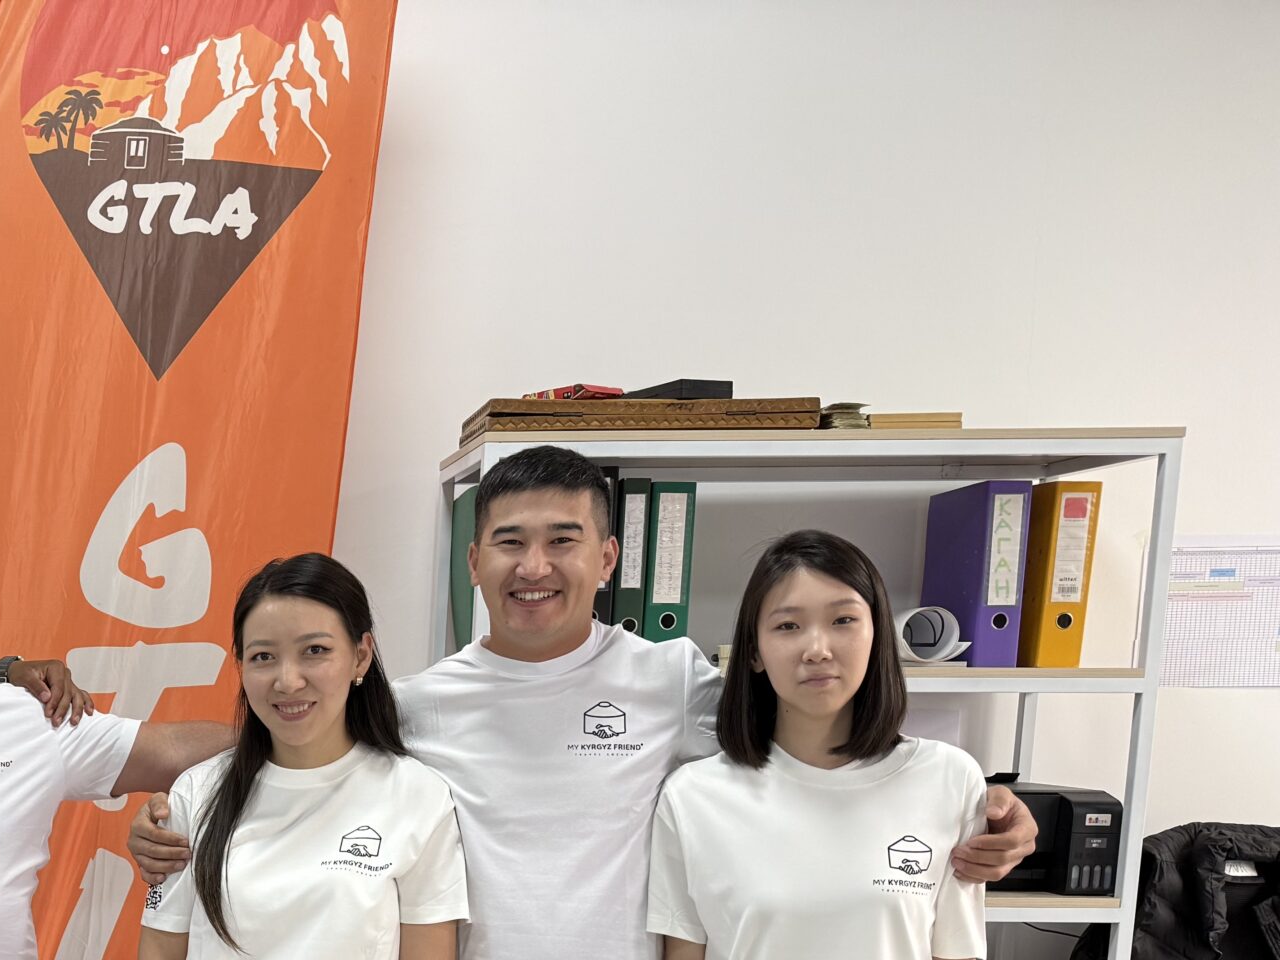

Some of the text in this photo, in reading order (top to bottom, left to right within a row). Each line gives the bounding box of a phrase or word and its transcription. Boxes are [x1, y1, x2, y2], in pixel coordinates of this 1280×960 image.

[87, 179, 259, 241] GTLA
[994, 497, 1012, 599] КАГАН
[333, 860, 362, 868] KYRGYZ
[363, 863, 389, 872] FRIEND
[888, 879, 916, 888] KYRGYZ
